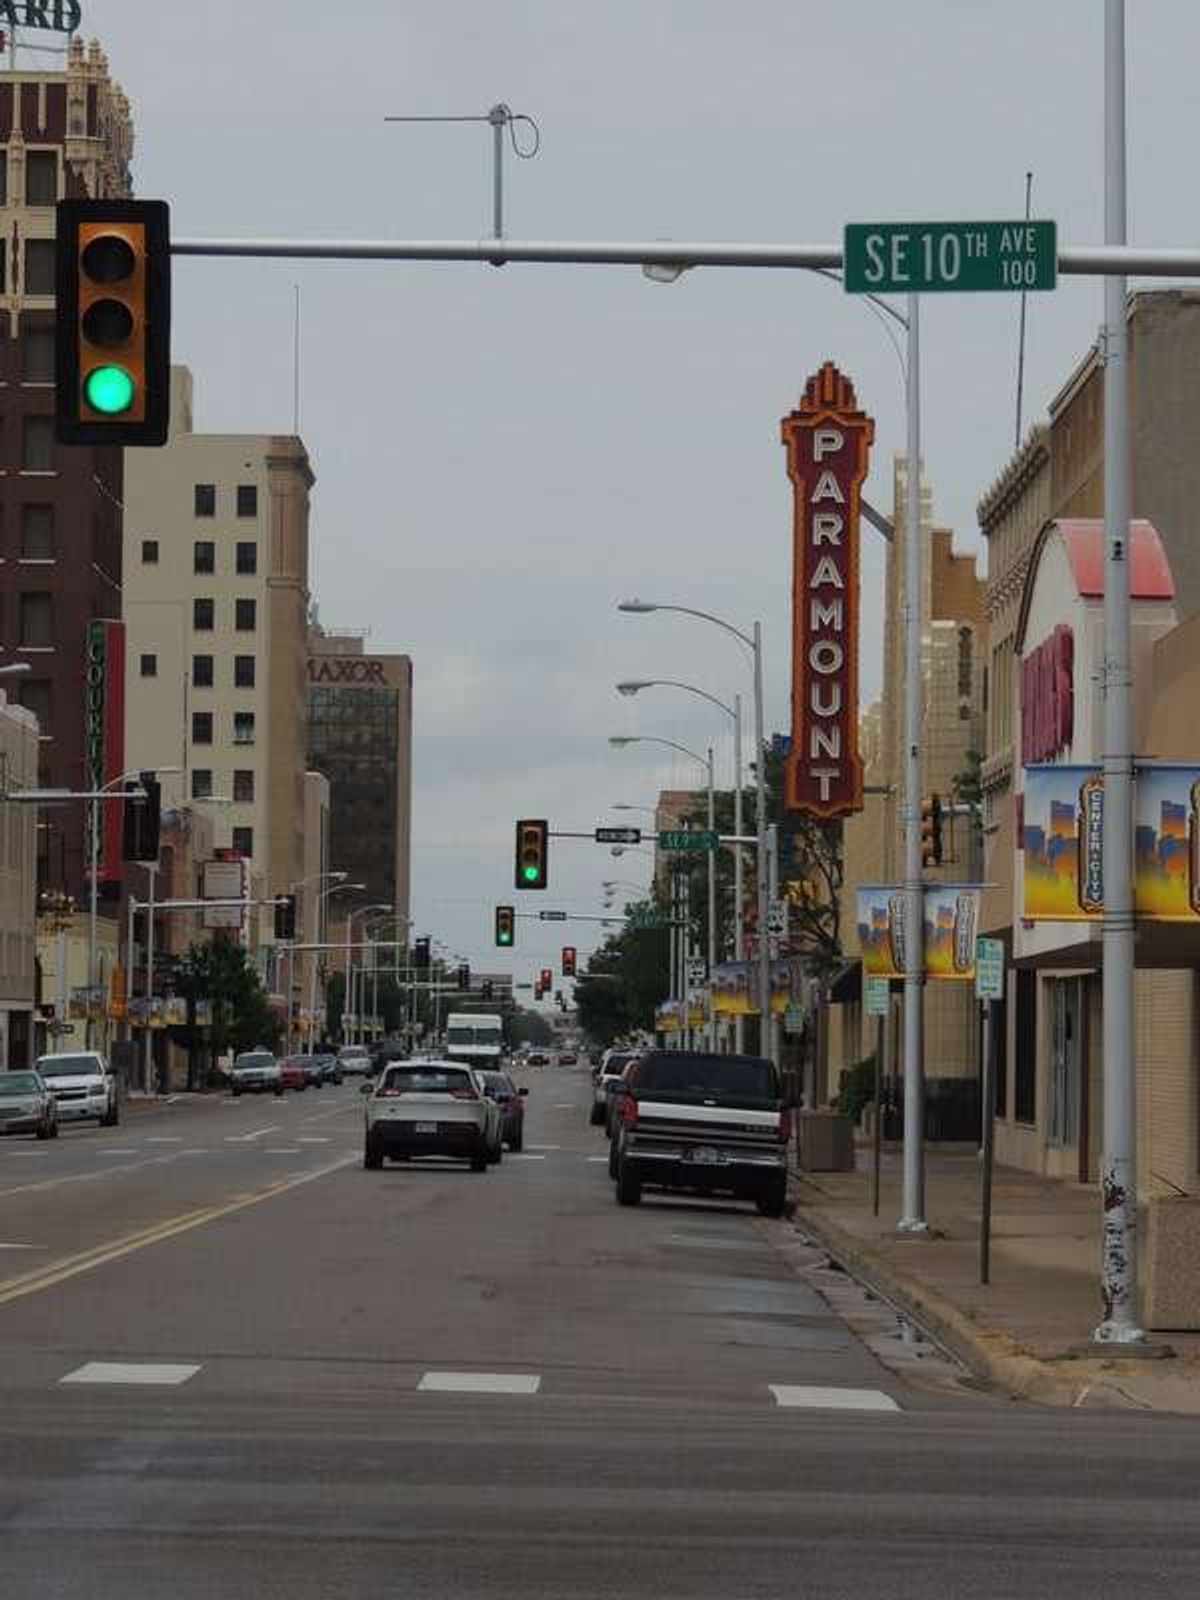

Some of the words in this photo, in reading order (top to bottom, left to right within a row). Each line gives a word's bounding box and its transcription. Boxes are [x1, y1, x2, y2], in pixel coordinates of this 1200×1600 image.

[865, 234, 911, 282] SE
[1000, 227, 1036, 253] AVE
[1003, 259, 1036, 284] 100
[809, 430, 845, 801] PARAMOUNT
[88, 641, 102, 864] COURTY
